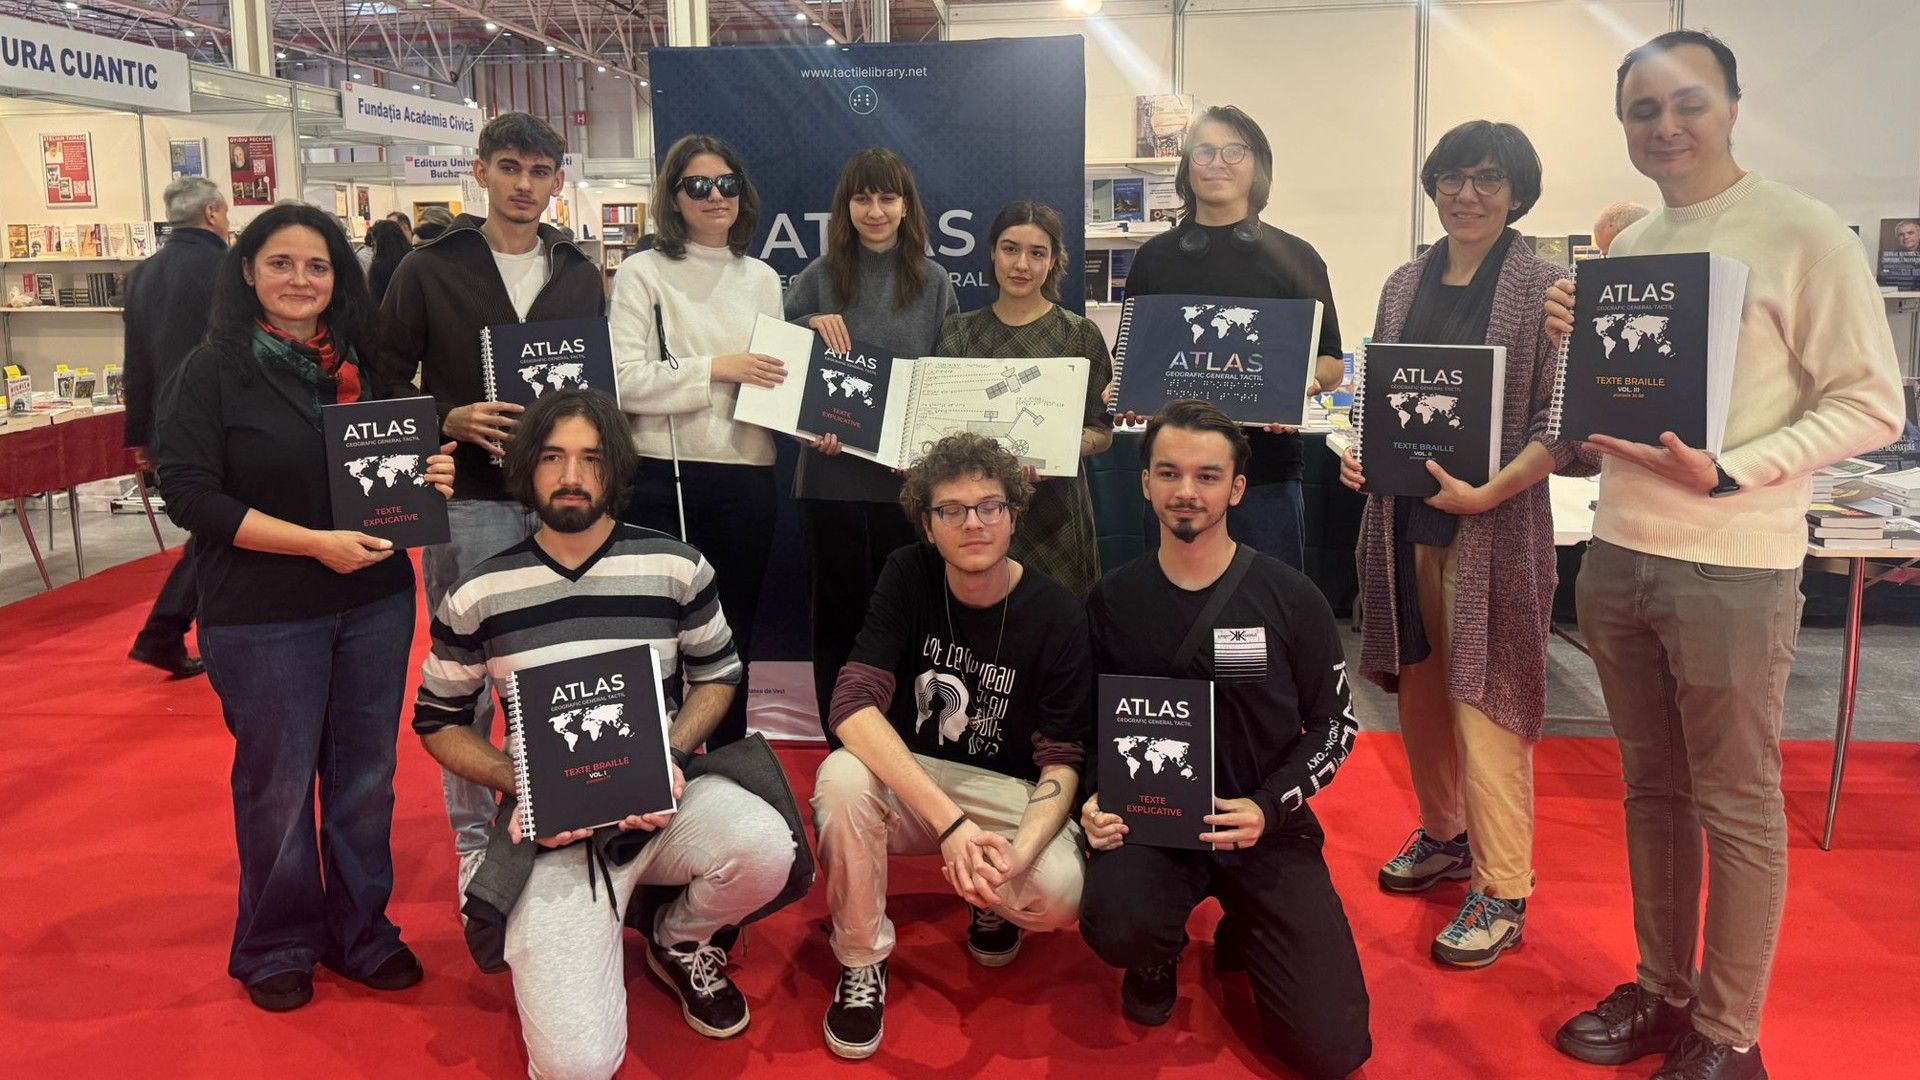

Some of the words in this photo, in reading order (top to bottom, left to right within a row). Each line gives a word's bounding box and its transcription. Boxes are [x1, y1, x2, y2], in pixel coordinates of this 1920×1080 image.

[1, 36, 56, 73] URA
[60, 48, 158, 90] CUANTIC
[800, 67, 928, 79] www.tactilelibrary.net
[403, 106, 448, 128] Academia
[449, 115, 474, 133] Civică
[414, 158, 448, 168] Editura
[1599, 282, 1675, 303] ATLAS
[521, 338, 586, 358] ATLAS
[1168, 351, 1263, 373] ATLAS
[1165, 371, 1205, 379] GEOGRAFIC
[1205, 372, 1239, 380] GENERAL
[1240, 374, 1263, 382] TACTIL
[1392, 367, 1463, 385] ATLAS
[1596, 377, 1622, 385] TEXTE
[1625, 377, 1665, 386] BRAILLE
[343, 419, 417, 440] ATLAS
[1393, 442, 1418, 450] TEXTE
[1419, 443, 1454, 452] BRAILLE
[375, 506, 402, 515] TEXTE
[363, 513, 419, 527] EXPLICATIVE
[551, 674, 625, 704] ATLAS
[550, 701, 581, 712] GEOGRAFIC
[581, 696, 607, 707] GENERAL
[1115, 697, 1190, 718] ATLAS
[564, 765, 591, 777] TEXTE
[593, 756, 630, 770] BRAILLE
[1139, 795, 1166, 804] TEXTE
[1127, 804, 1182, 817] EXPLICATIVE
